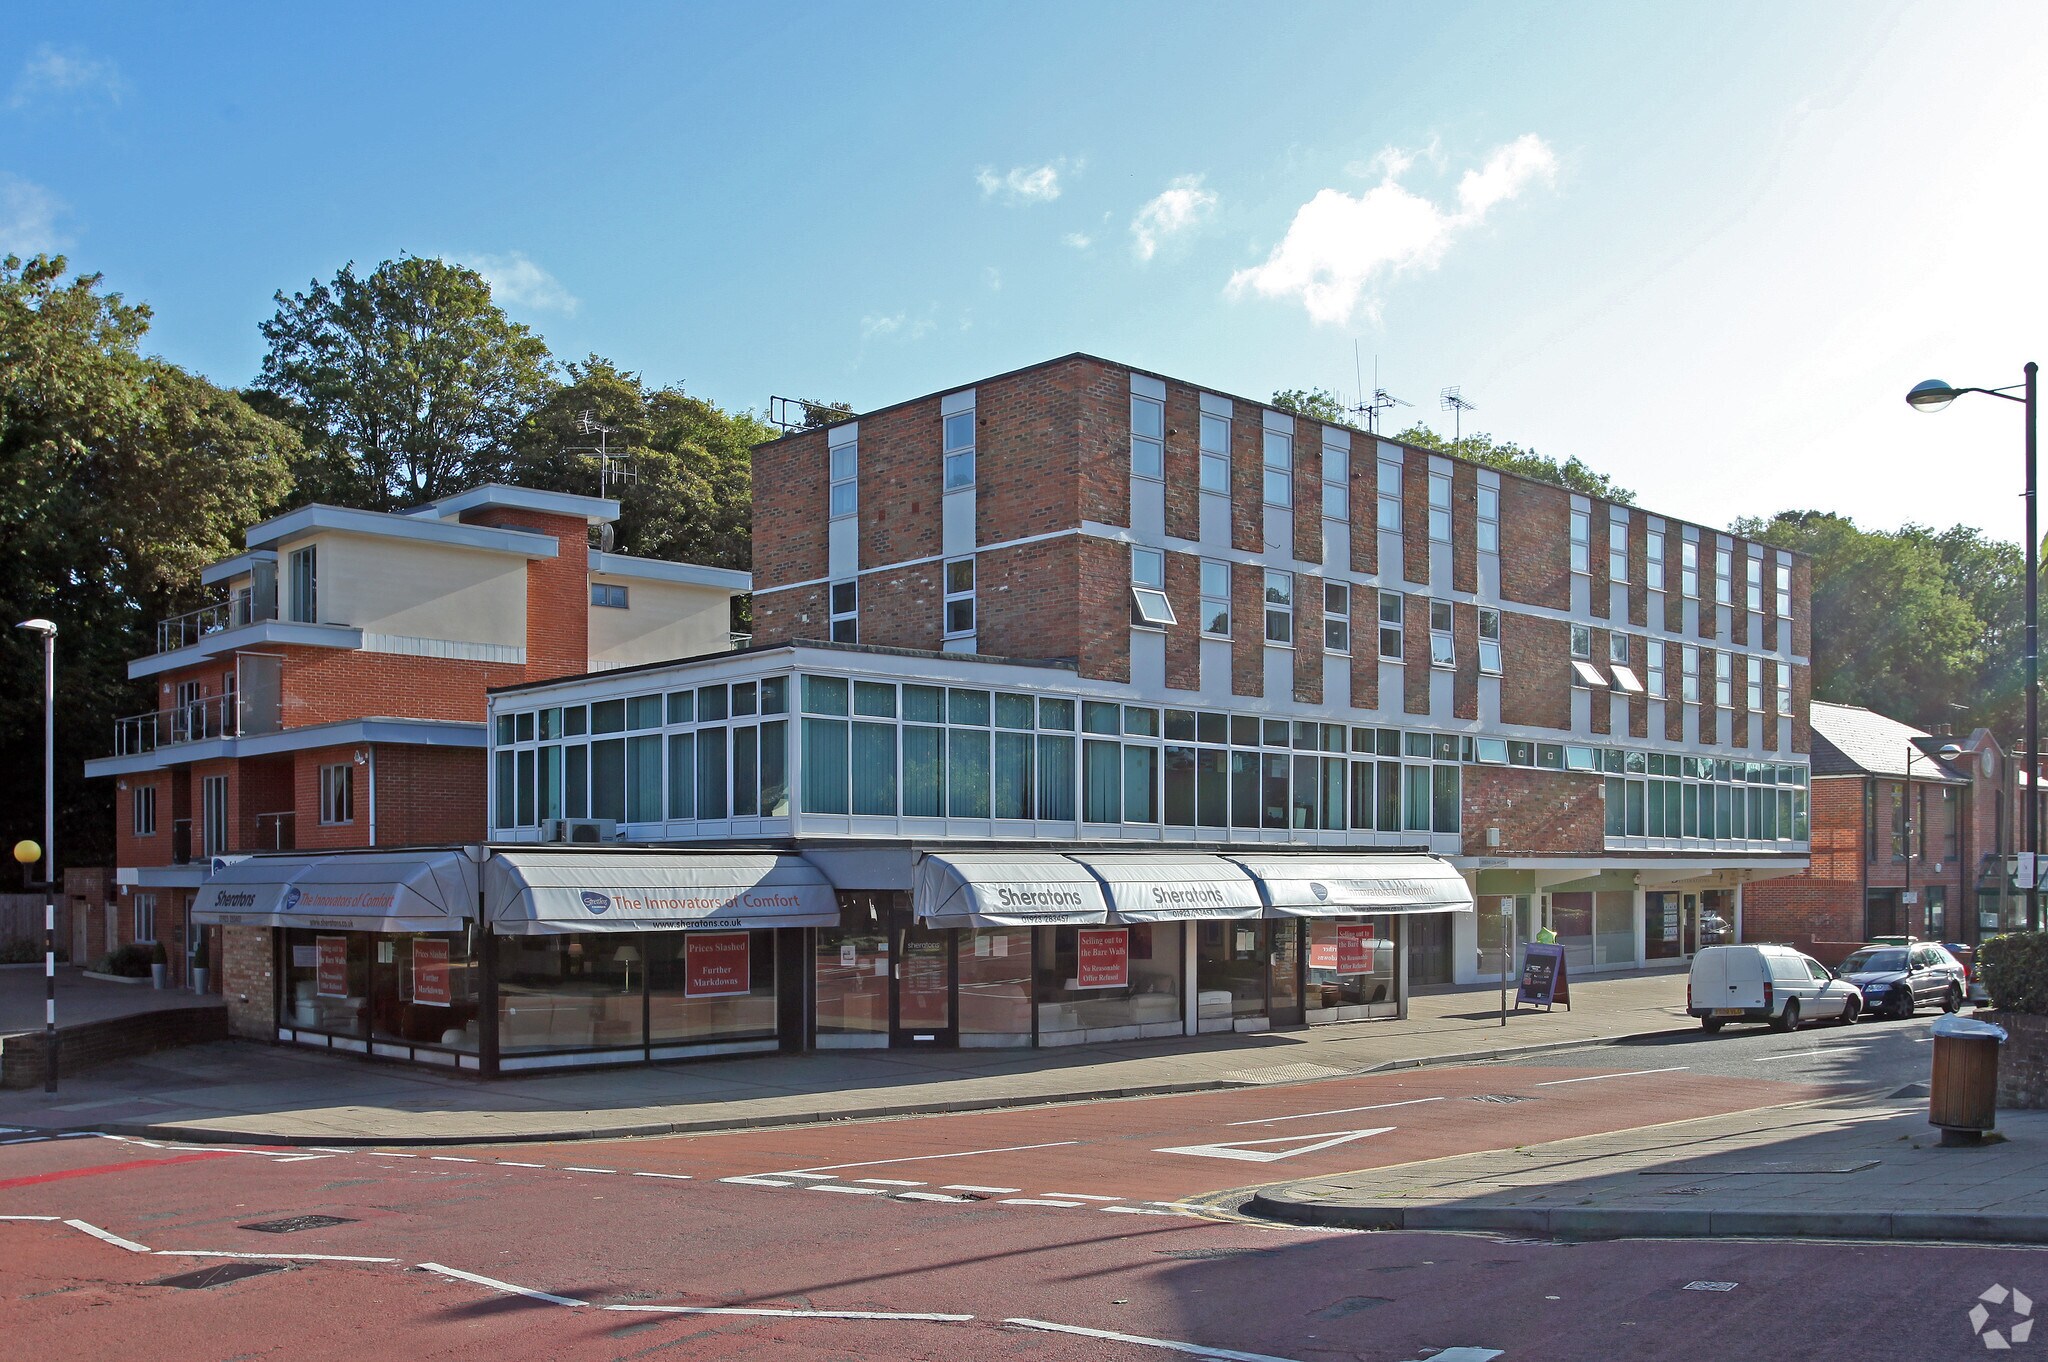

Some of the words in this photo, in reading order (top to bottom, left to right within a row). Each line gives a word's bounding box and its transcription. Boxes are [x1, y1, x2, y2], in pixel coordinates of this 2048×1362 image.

[1152, 887, 1223, 904] Sheratons
[1392, 885, 1401, 896] of
[1402, 884, 1437, 897] Comfort
[215, 890, 256, 907] Sheratons
[300, 892, 313, 906] The
[314, 894, 352, 907] Innovators
[353, 893, 363, 907] of
[363, 892, 395, 908] Comfort
[612, 896, 641, 910] The
[644, 896, 721, 910] Innovators
[725, 895, 739, 908] of
[743, 894, 800, 908] Comfort
[998, 888, 1082, 906] Sheratons
[310, 919, 354, 928] www.sheratons.co.uk
[653, 918, 742, 929] www.sheratons.co.uk
[1022, 915, 1042, 923] 01923
[1045, 914, 1069, 923] 283457
[1081, 937, 1103, 946] Selling
[689, 944, 713, 953] Prices
[715, 942, 745, 951] Slashed
[1081, 949, 1091, 957] the
[1092, 948, 1108, 956] Bare
[1109, 947, 1126, 955] Walls
[702, 966, 732, 975] Further
[1092, 964, 1121, 972] Reasonable
[423, 973, 439, 982] Further
[694, 978, 738, 987] Markdowns
[418, 985, 444, 995] Markdowns
